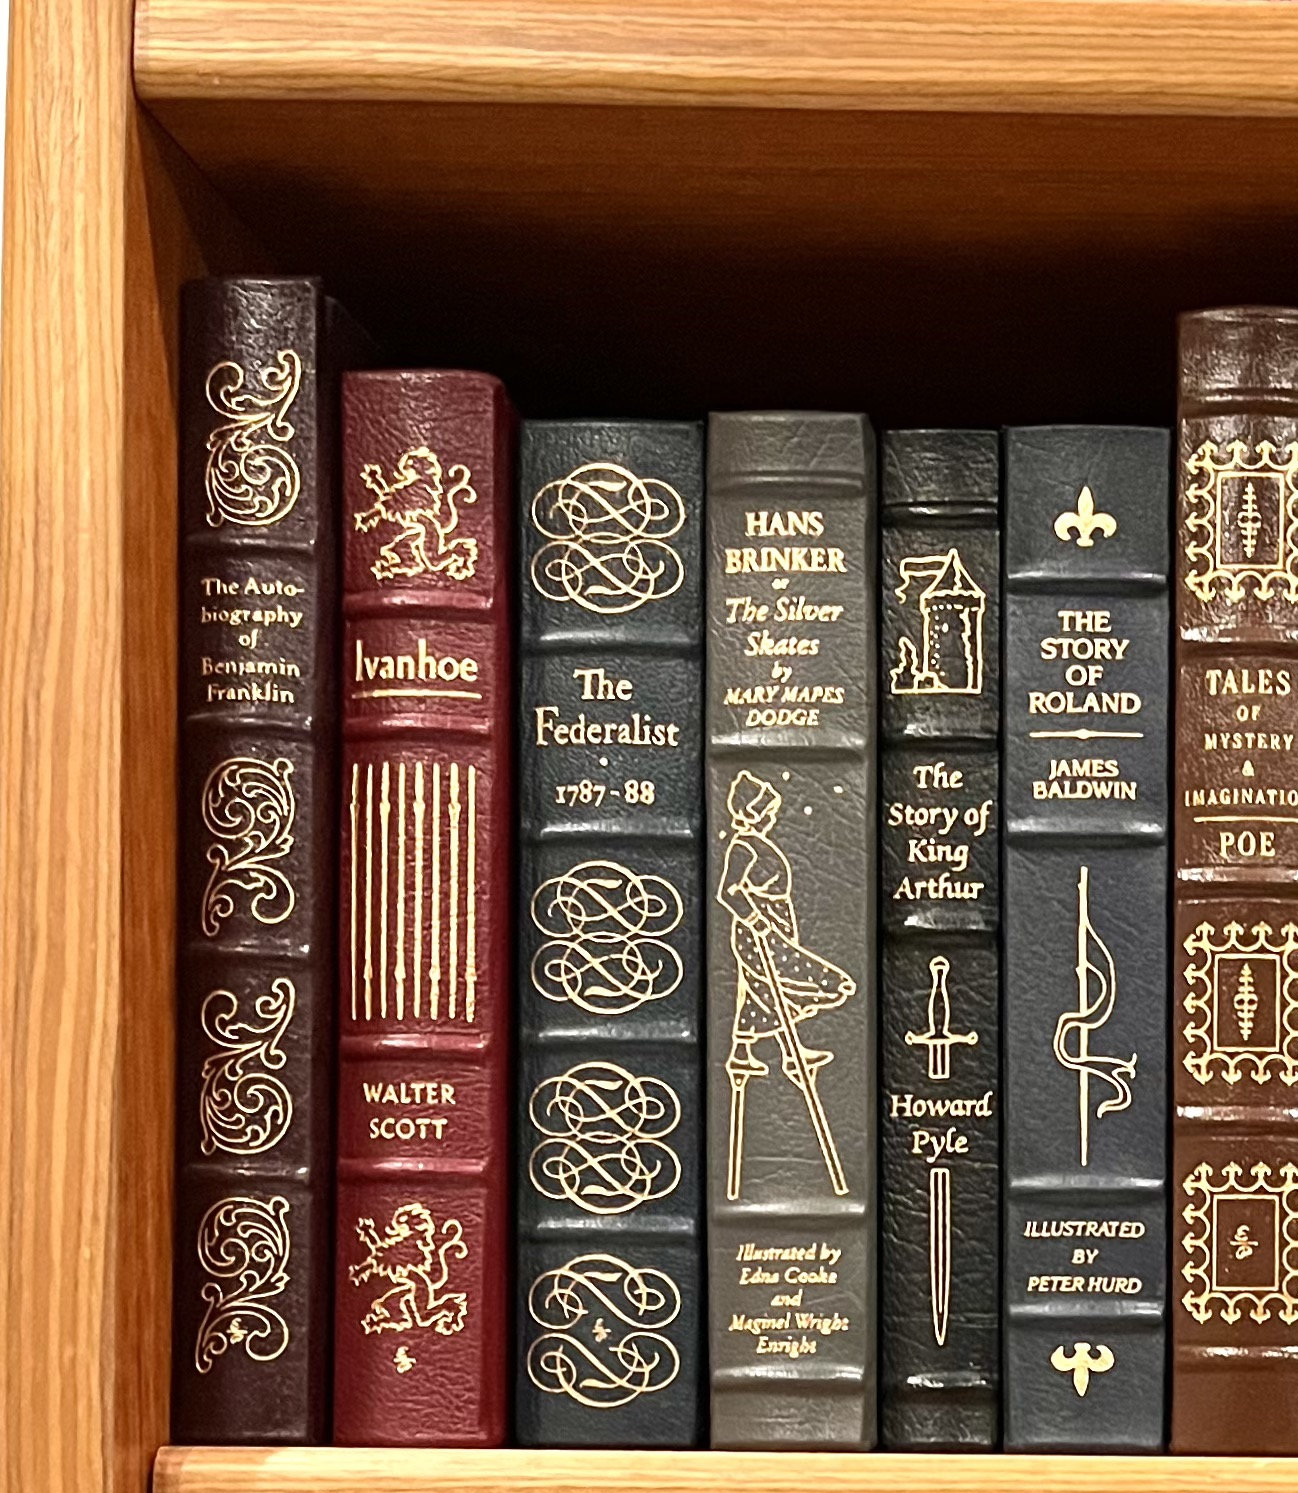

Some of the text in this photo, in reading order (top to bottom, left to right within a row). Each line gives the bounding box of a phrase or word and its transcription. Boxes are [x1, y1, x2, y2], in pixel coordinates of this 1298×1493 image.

[744, 510, 825, 537] HANS
[724, 546, 848, 574] BRINKER
[203, 578, 241, 598] The
[201, 605, 304, 628] biography
[725, 594, 845, 624] The Silver
[1057, 609, 1112, 633] THE
[238, 629, 259, 650] of
[743, 629, 821, 657] Skates
[1040, 637, 1130, 661] STORY
[201, 657, 301, 680] Benjamin
[355, 638, 478, 683] Ivanhoe
[770, 660, 793, 684] by
[573, 667, 633, 701] The
[1064, 664, 1104, 687] OF
[1204, 668, 1292, 697] TALES
[207, 682, 295, 705] Franklin
[723, 684, 845, 706] MARY MAPES
[1027, 691, 1143, 715] ROLAND
[745, 708, 820, 727] DODGE
[1235, 704, 1262, 722] OF
[534, 706, 680, 748] Federalist
[1203, 732, 1295, 751] MYSTERY
[912, 761, 964, 789] The
[1048, 758, 1120, 781] JAMES
[1032, 780, 1137, 801] BALDWIN
[887, 799, 993, 837] Story of
[907, 837, 969, 872] King
[1218, 830, 1276, 858] POE
[892, 872, 985, 901] Arthur
[362, 1081, 457, 1106] WALTER
[889, 1090, 994, 1118] Howard
[368, 1117, 449, 1141] SCOTT
[911, 1126, 970, 1164] Pyle
[1023, 1220, 1146, 1239] ILLUSTRATED
[735, 1241, 843, 1266] Illustrated by
[1071, 1248, 1099, 1265] BY
[1026, 1275, 1143, 1294] PETER HURD
[769, 1287, 804, 1308] and
